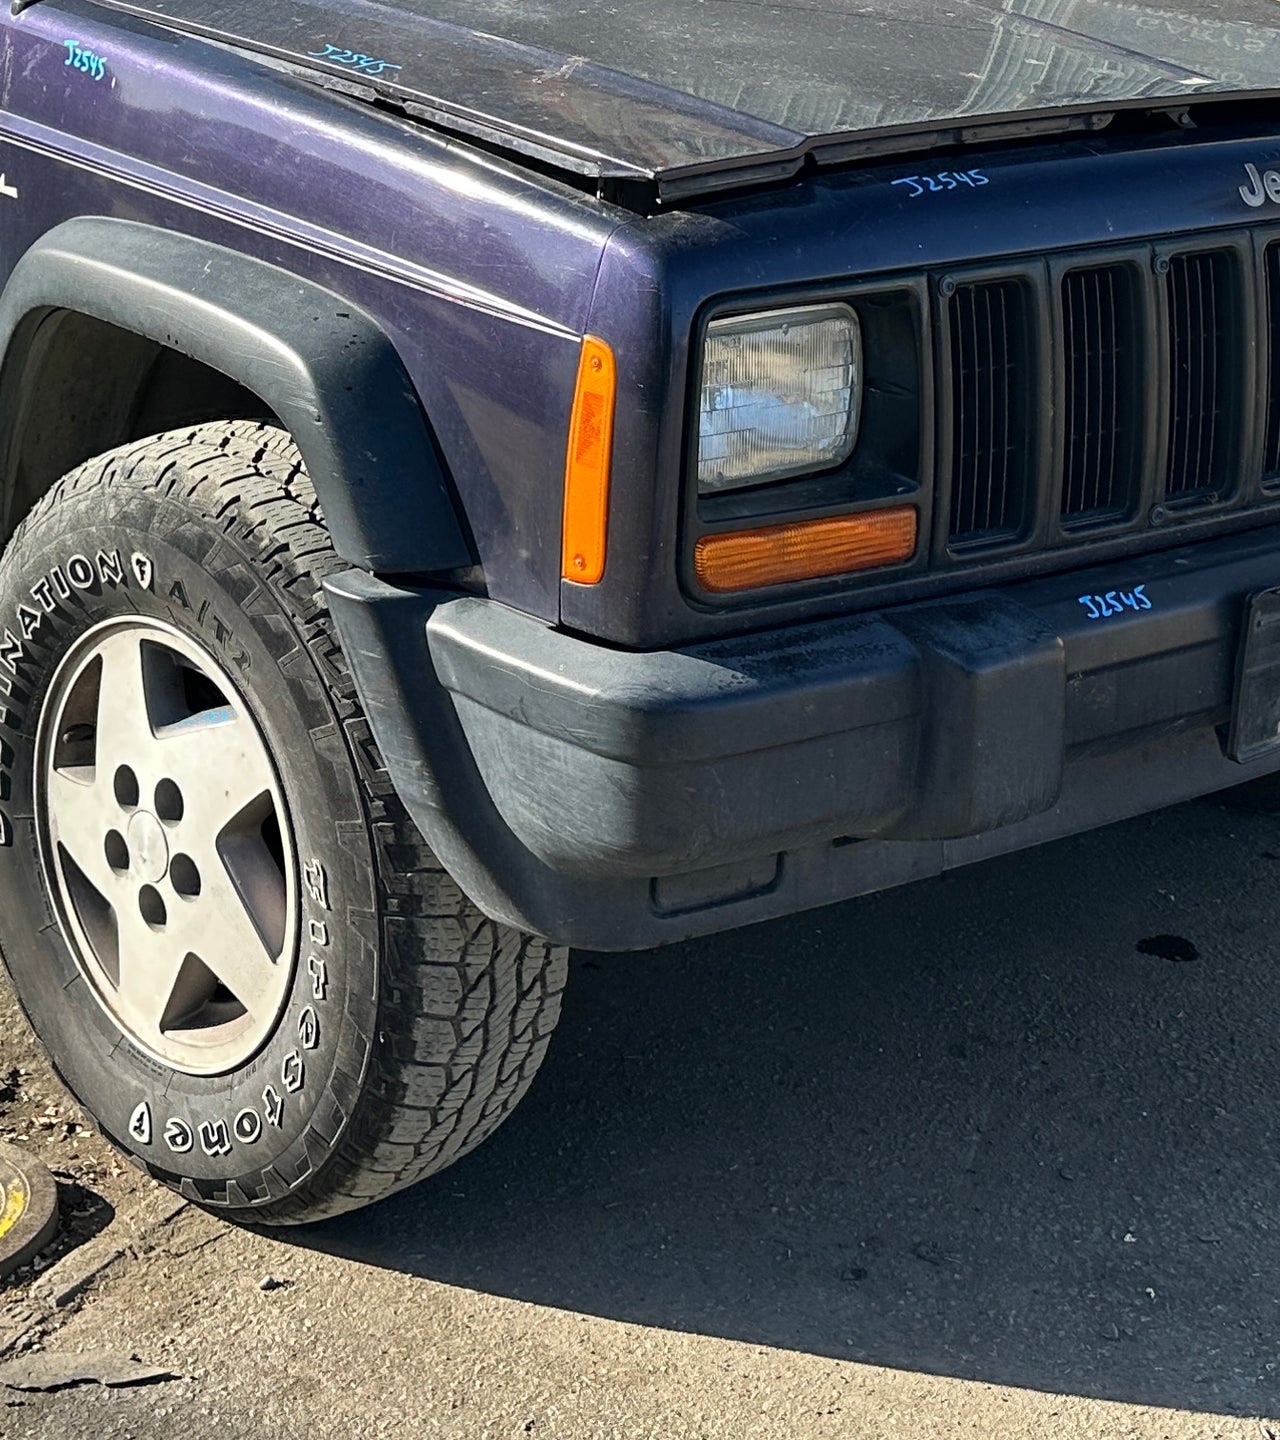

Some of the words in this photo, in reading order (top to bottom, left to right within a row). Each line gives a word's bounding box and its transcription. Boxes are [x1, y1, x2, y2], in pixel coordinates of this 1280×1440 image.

[63, 39, 108, 81] J2545
[890, 168, 990, 198] J2545
[1078, 584, 1152, 619] J2545
[163, 857, 333, 1156] Firestone
